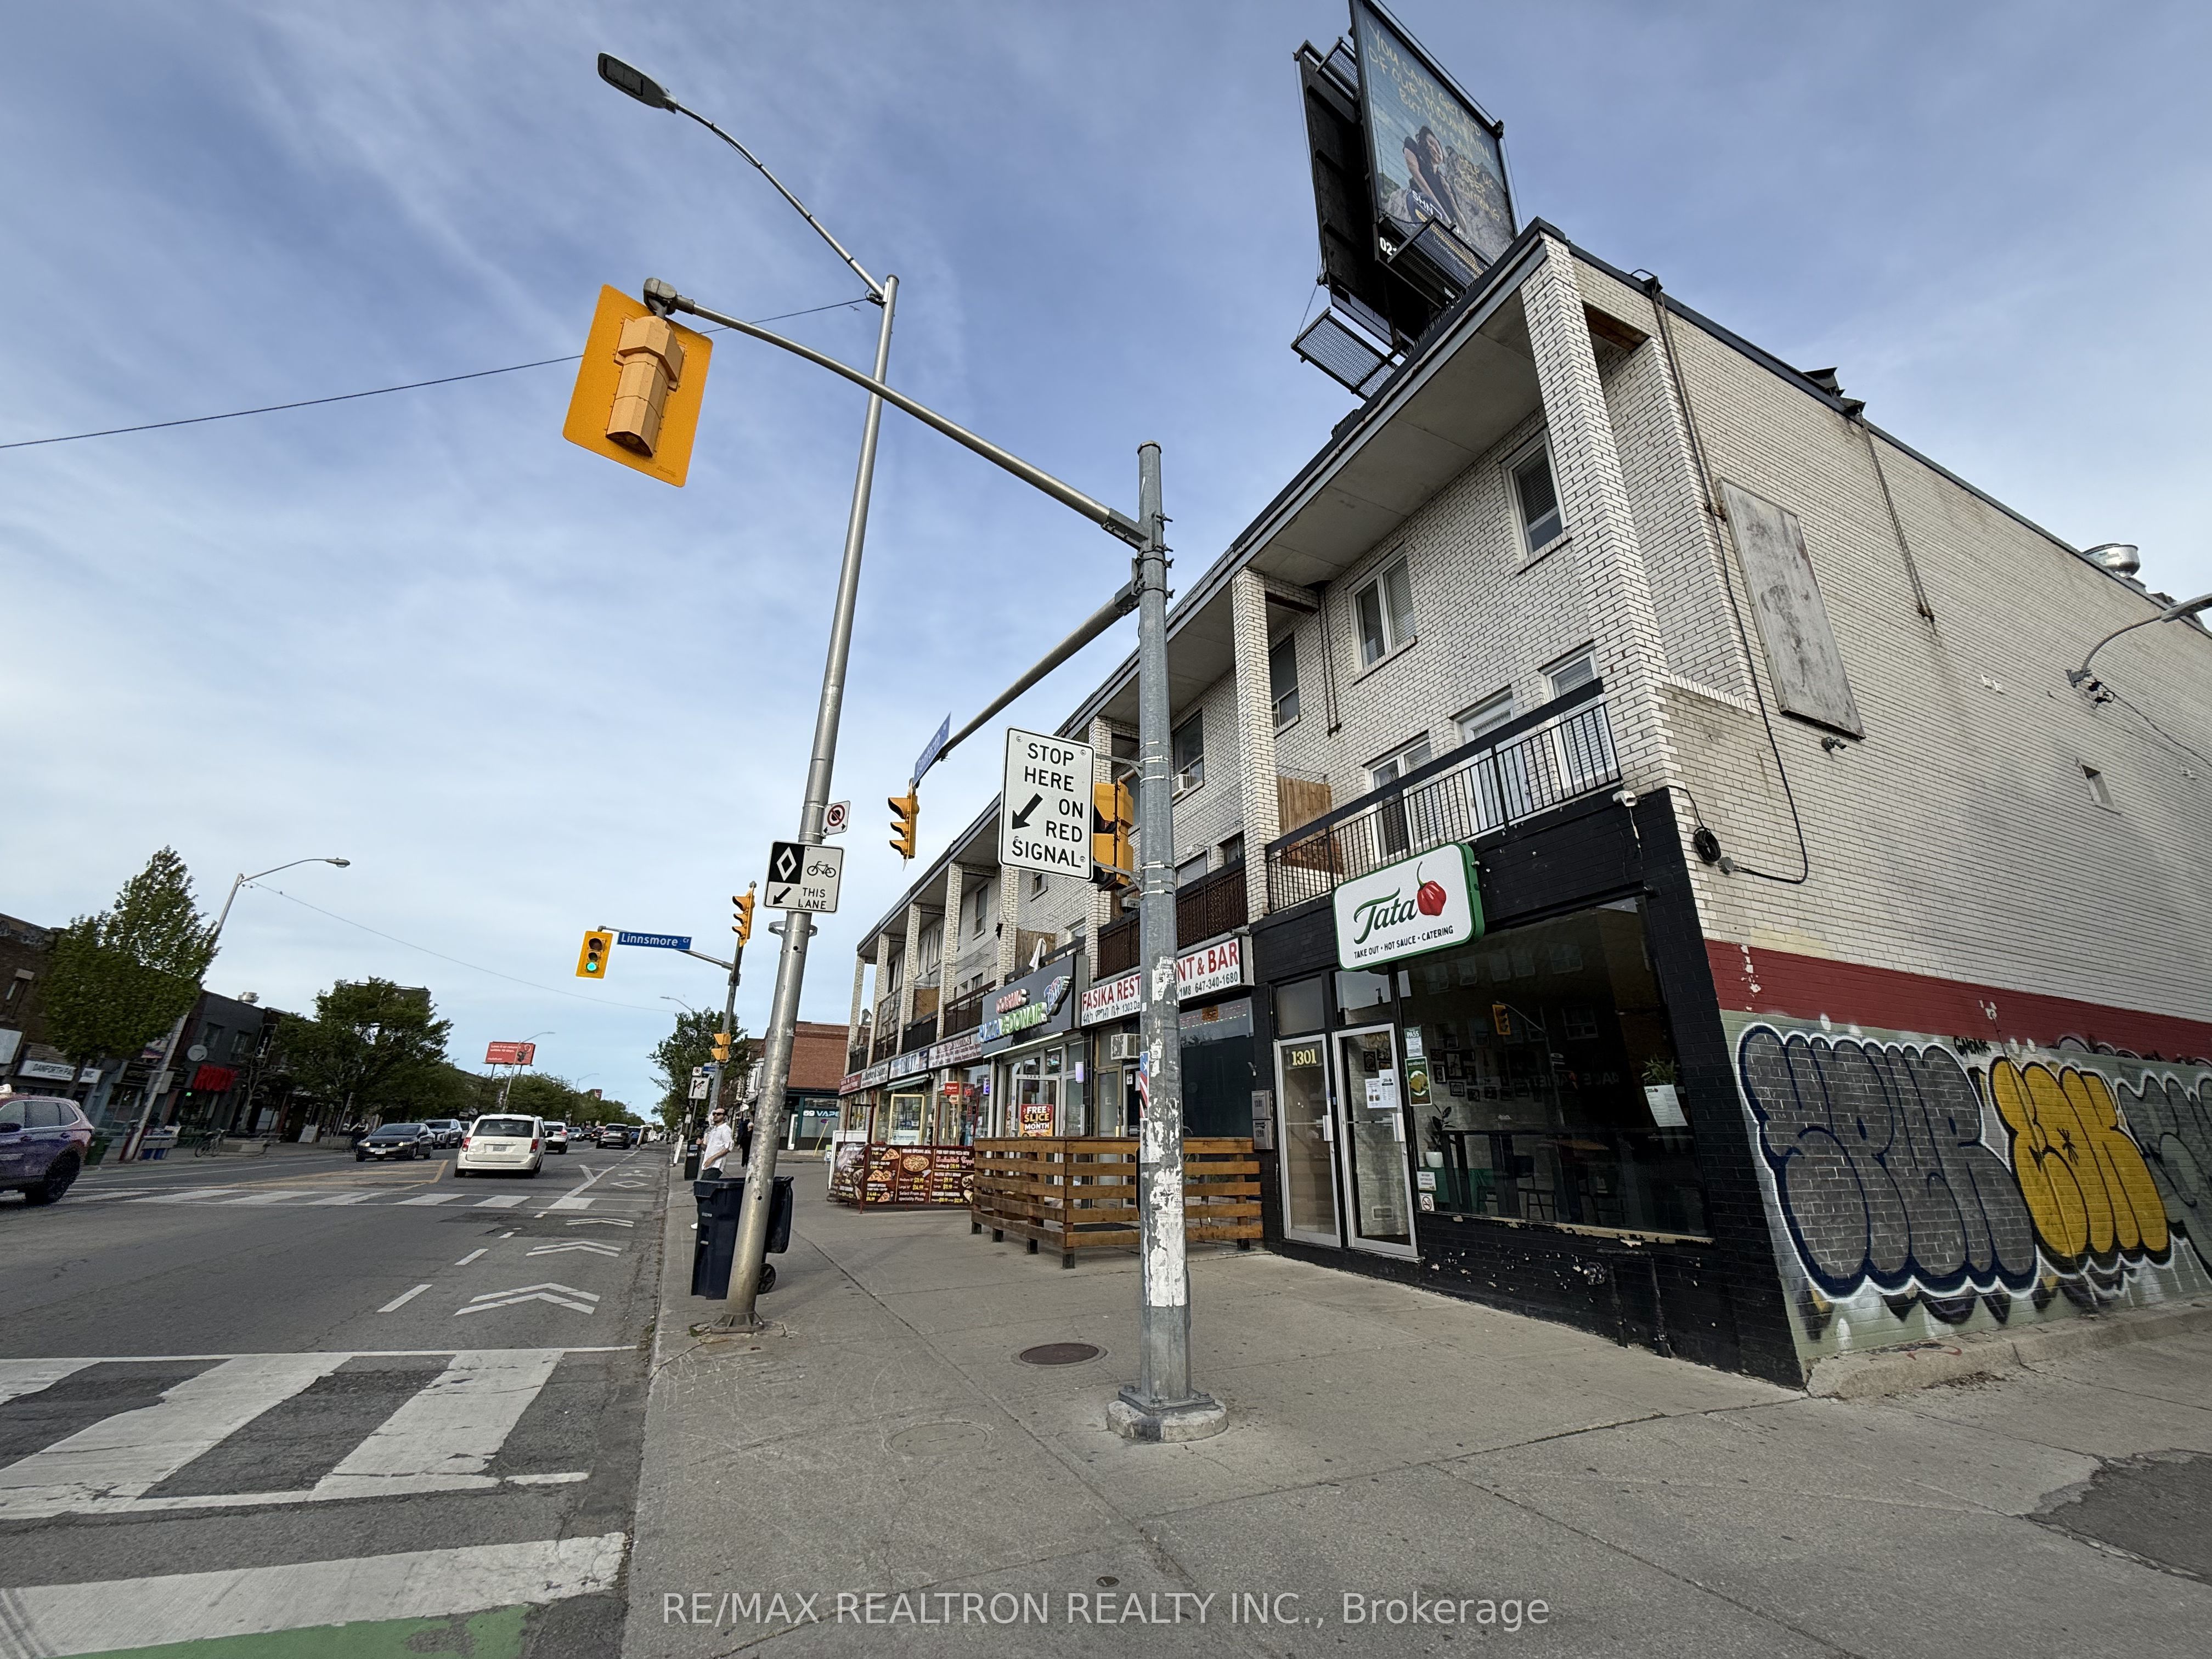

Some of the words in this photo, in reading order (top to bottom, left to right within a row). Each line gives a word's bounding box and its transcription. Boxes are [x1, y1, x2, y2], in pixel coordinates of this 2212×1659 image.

[1367, 20, 1398, 66] YOU
[1438, 92, 1458, 119] GET
[1368, 46, 1388, 75] OF
[1392, 67, 1422, 104] OUR
[1399, 87, 1420, 117] BUT
[1028, 743, 1074, 766] STOP
[1025, 766, 1074, 792] HERE
[1059, 798, 1084, 819] ON
[1046, 820, 1082, 843] RED
[1012, 839, 1081, 868] SIGNAL
[798, 899, 827, 910] LANE
[802, 887, 826, 898] THIS
[1353, 887, 1418, 945] Tata
[620, 932, 679, 947] Linnsmore
[1354, 949, 1368, 959] TAKE
[1369, 946, 1379, 955] OUT
[1384, 941, 1396, 950] HOT
[1396, 936, 1417, 948] SAUCE
[1421, 925, 1454, 941] CATERING
[1082, 986, 1114, 1012] FASIKA
[1197, 956, 1205, 976] &
[1208, 941, 1238, 974] BAR
[996, 989, 1026, 1014] COSMIC
[1122, 1002, 1133, 1013] 1303
[1195, 970, 1238, 993] 647-340-1680
[979, 1020, 1000, 1042] PIZZA
[1009, 1002, 1047, 1033] DONAIR
[32, 1063, 64, 1075] DANFORTH
[1291, 1048, 1317, 1066] 1301
[1024, 1113, 1049, 1122] SLICE
[1026, 1106, 1047, 1114] FREE
[1024, 1122, 1050, 1131] MONTH
